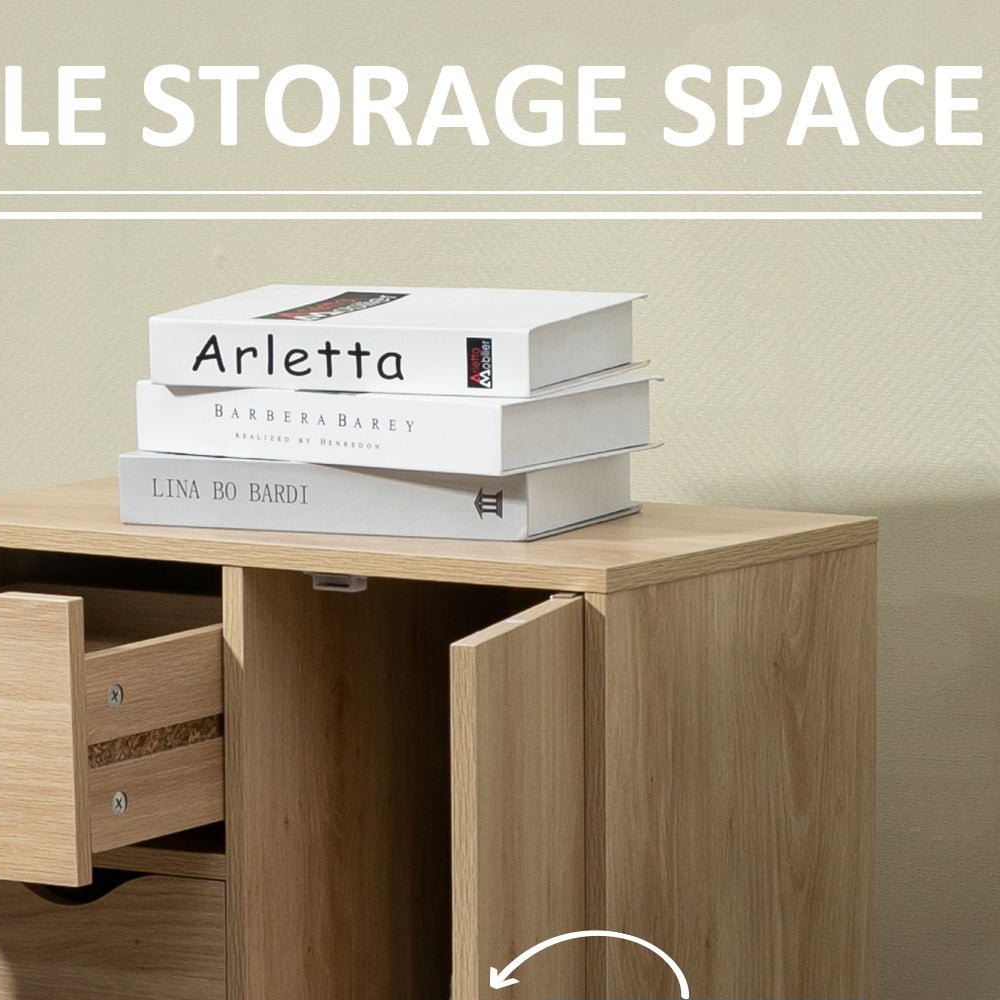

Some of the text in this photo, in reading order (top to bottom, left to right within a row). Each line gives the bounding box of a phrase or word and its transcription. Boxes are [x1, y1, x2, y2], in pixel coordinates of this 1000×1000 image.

[191, 333, 405, 382] Arletta
[213, 403, 415, 433] BARBERA BAREY
[234, 432, 290, 443] REALIZED
[298, 437, 311, 445] BY
[152, 477, 309, 504] LINA BO BARDI
